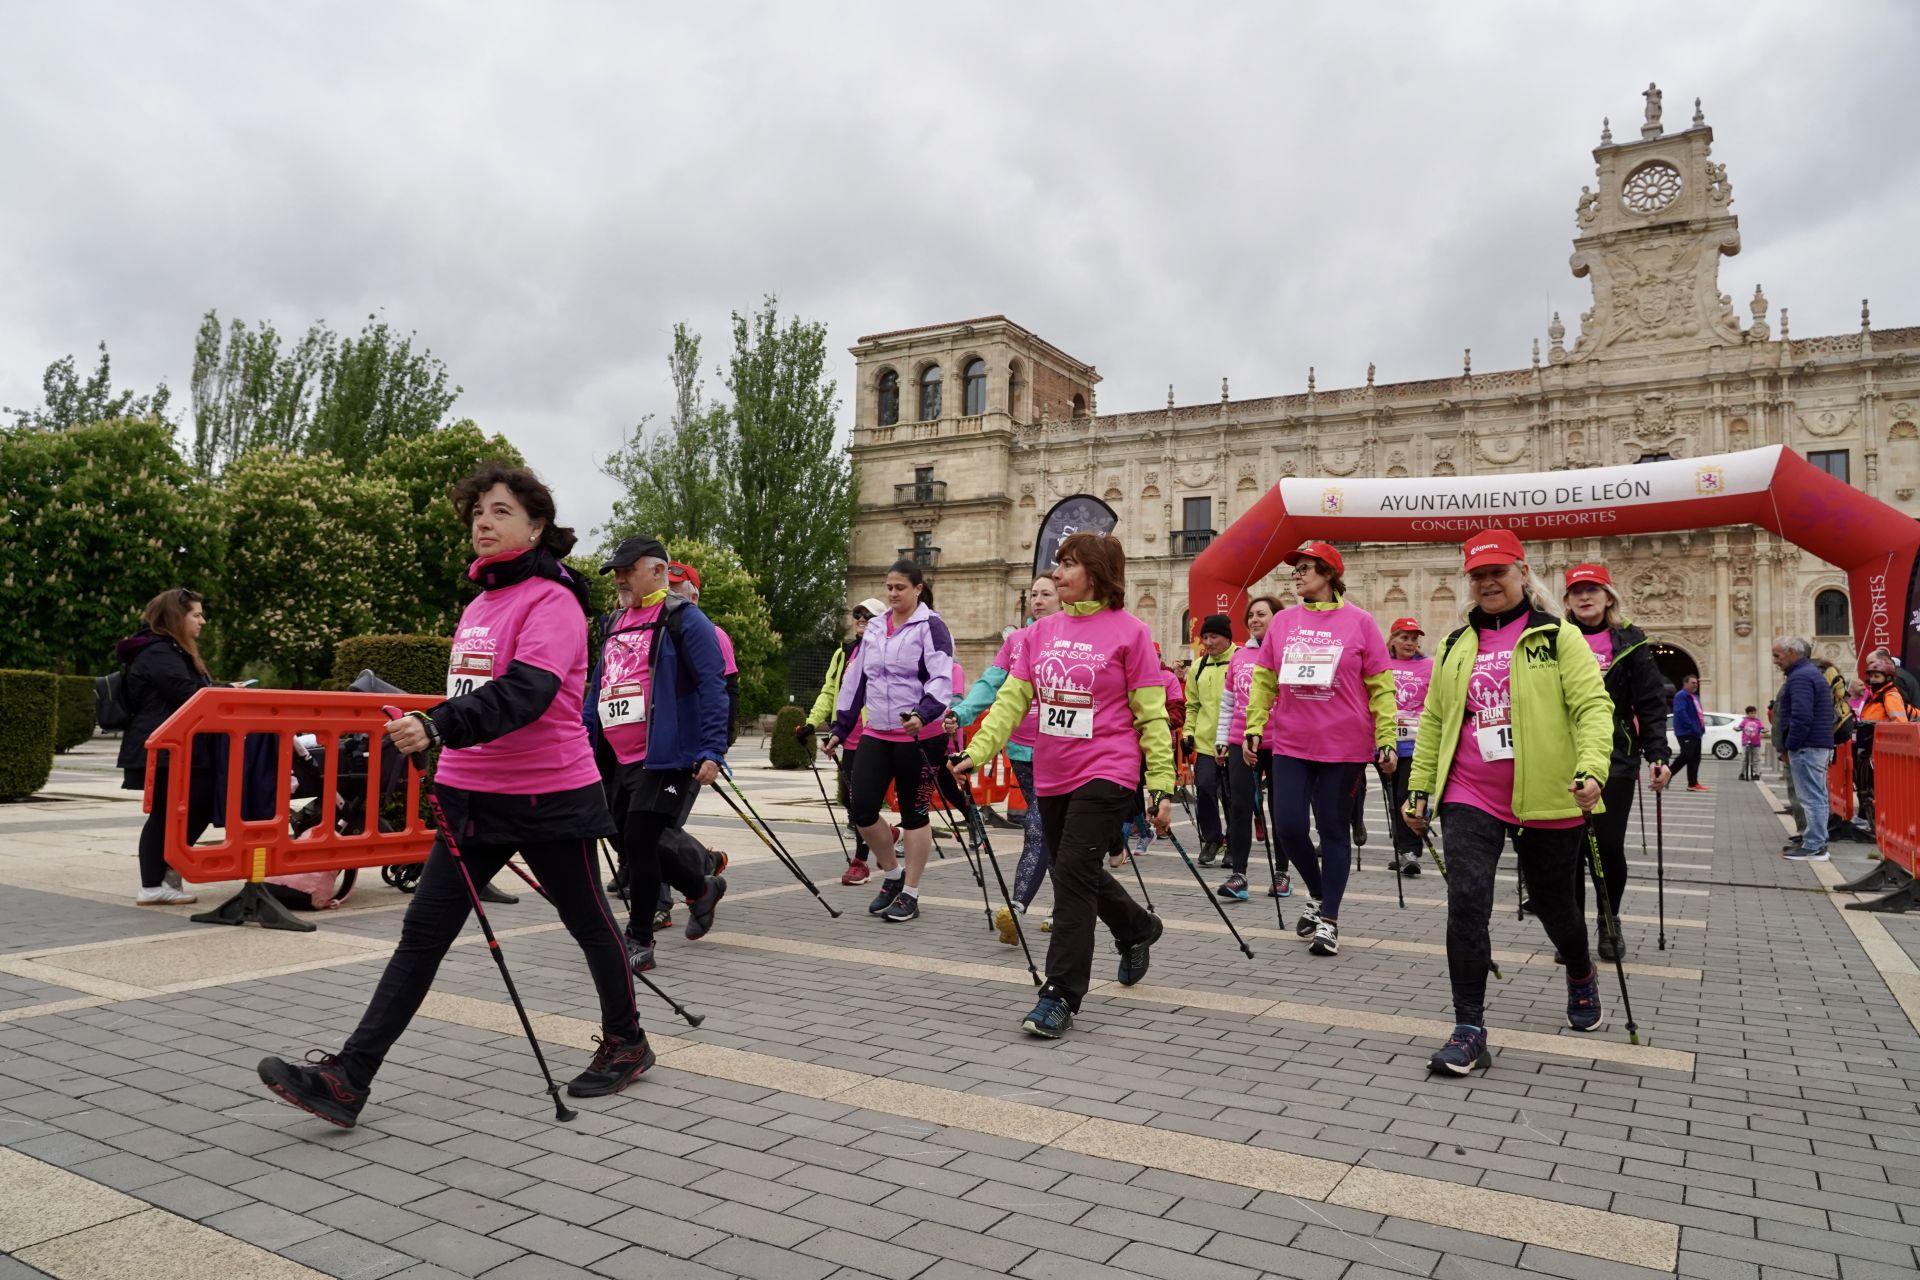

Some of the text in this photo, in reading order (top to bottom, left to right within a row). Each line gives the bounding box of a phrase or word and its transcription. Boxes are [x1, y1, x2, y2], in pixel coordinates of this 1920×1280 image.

[1380, 478, 1651, 511] AYUNTAMIENTO DE LEÓN
[1411, 510, 1617, 531] CONCEJALÍA DE DEPORTES
[1299, 629, 1332, 638] RUN FOR
[1053, 640, 1093, 652] RUN FOR
[1477, 650, 1512, 662] RUN FO
[1298, 665, 1316, 678] 25
[608, 700, 630, 718] 312
[1481, 706, 1505, 721] RUN
[1048, 708, 1077, 728] 247
[1397, 727, 1408, 737] 19
